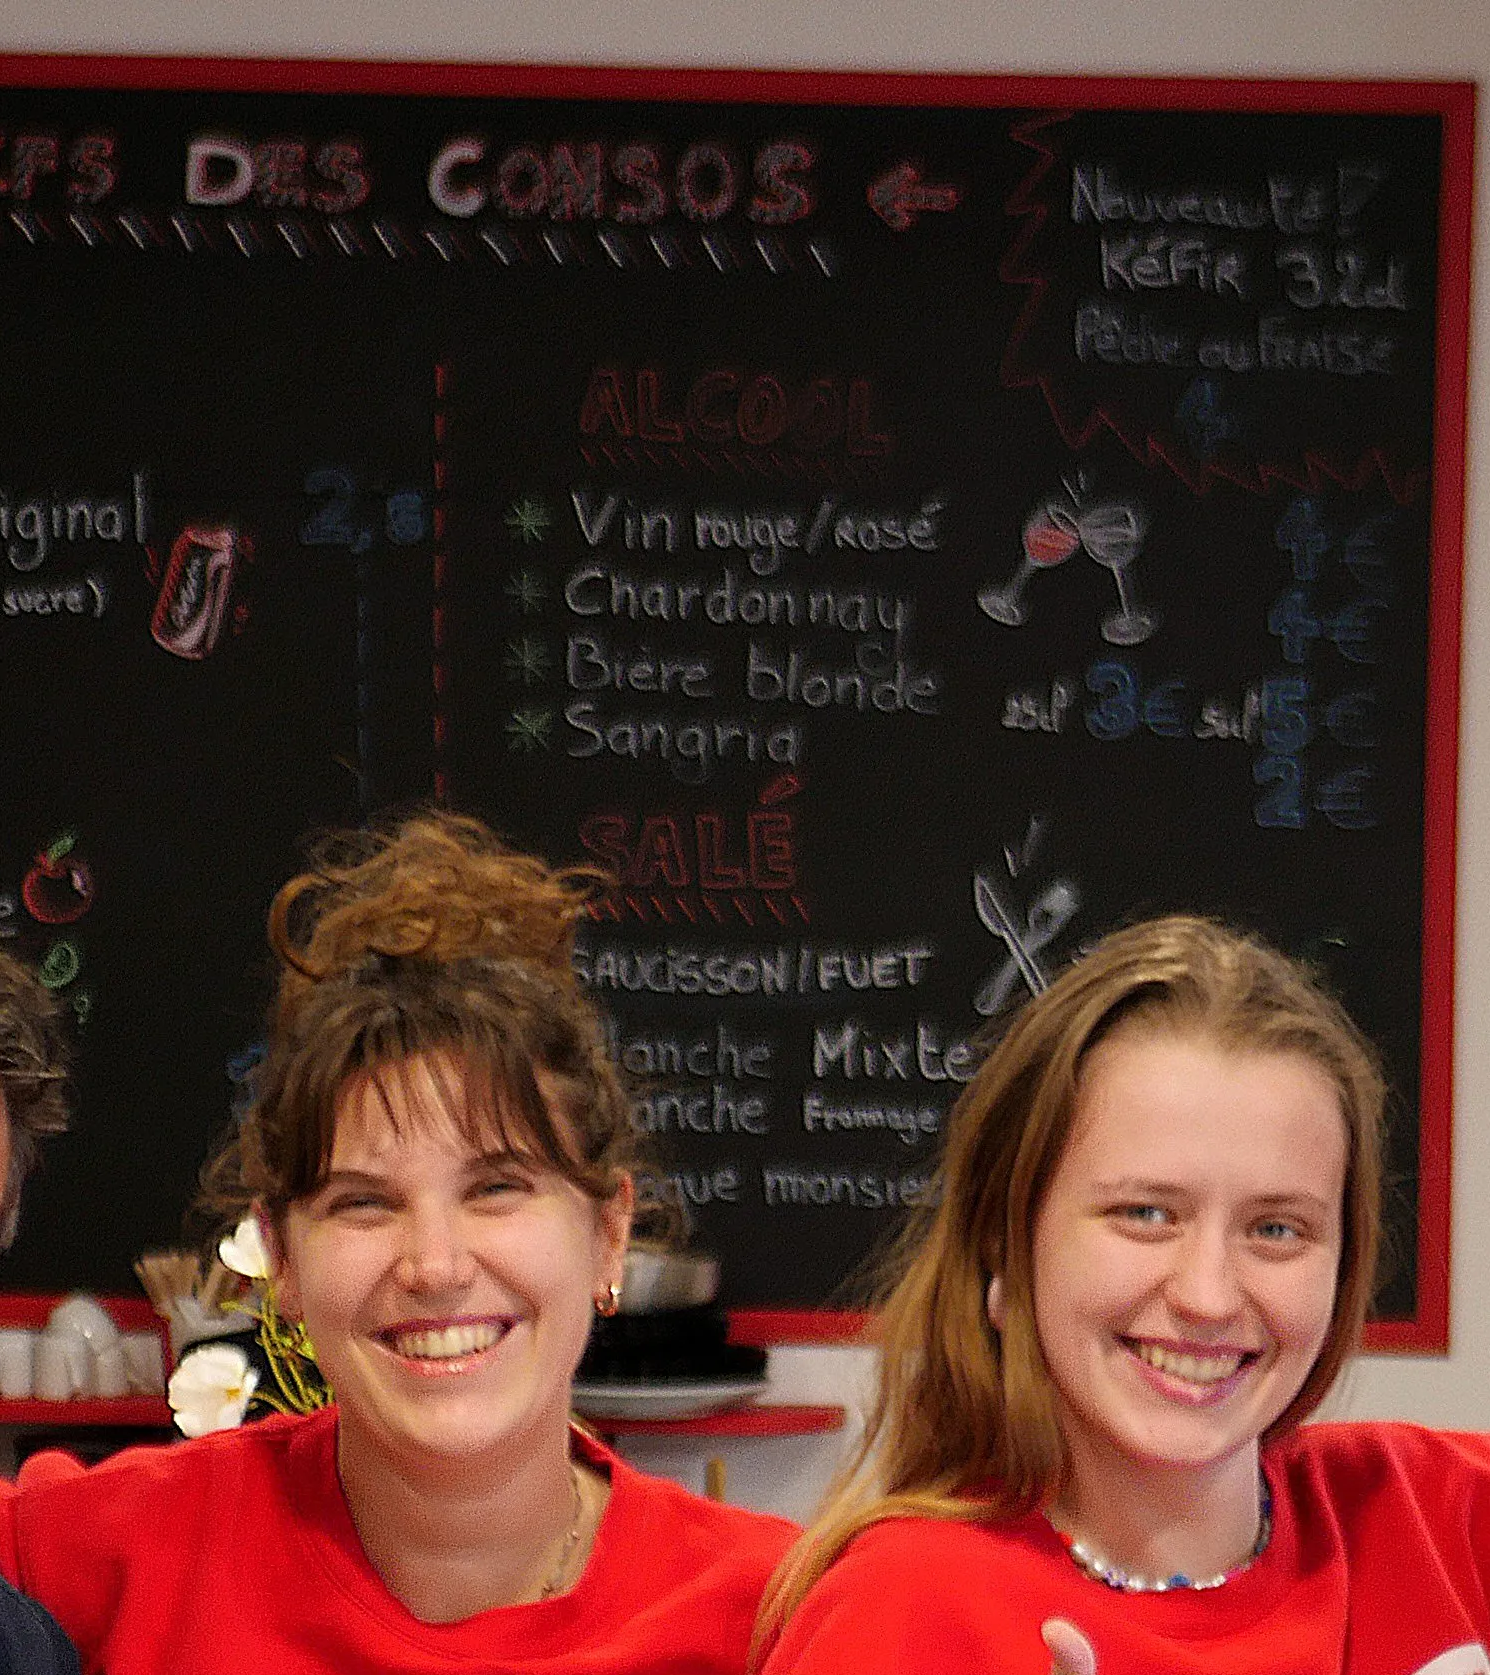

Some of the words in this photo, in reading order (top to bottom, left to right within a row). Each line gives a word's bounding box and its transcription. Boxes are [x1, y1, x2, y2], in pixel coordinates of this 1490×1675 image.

[186, 134, 371, 214] DES
[428, 136, 813, 226] CONSOS
[580, 368, 893, 456] ALCOOL
[572, 492, 674, 551] Vin
[565, 567, 908, 676] Chardonnay
[566, 635, 711, 698] Bière
[748, 640, 941, 715] blonde
[565, 703, 801, 784] Sangria
[579, 773, 804, 890] SALÉ
[813, 1020, 977, 1082] Mixte
